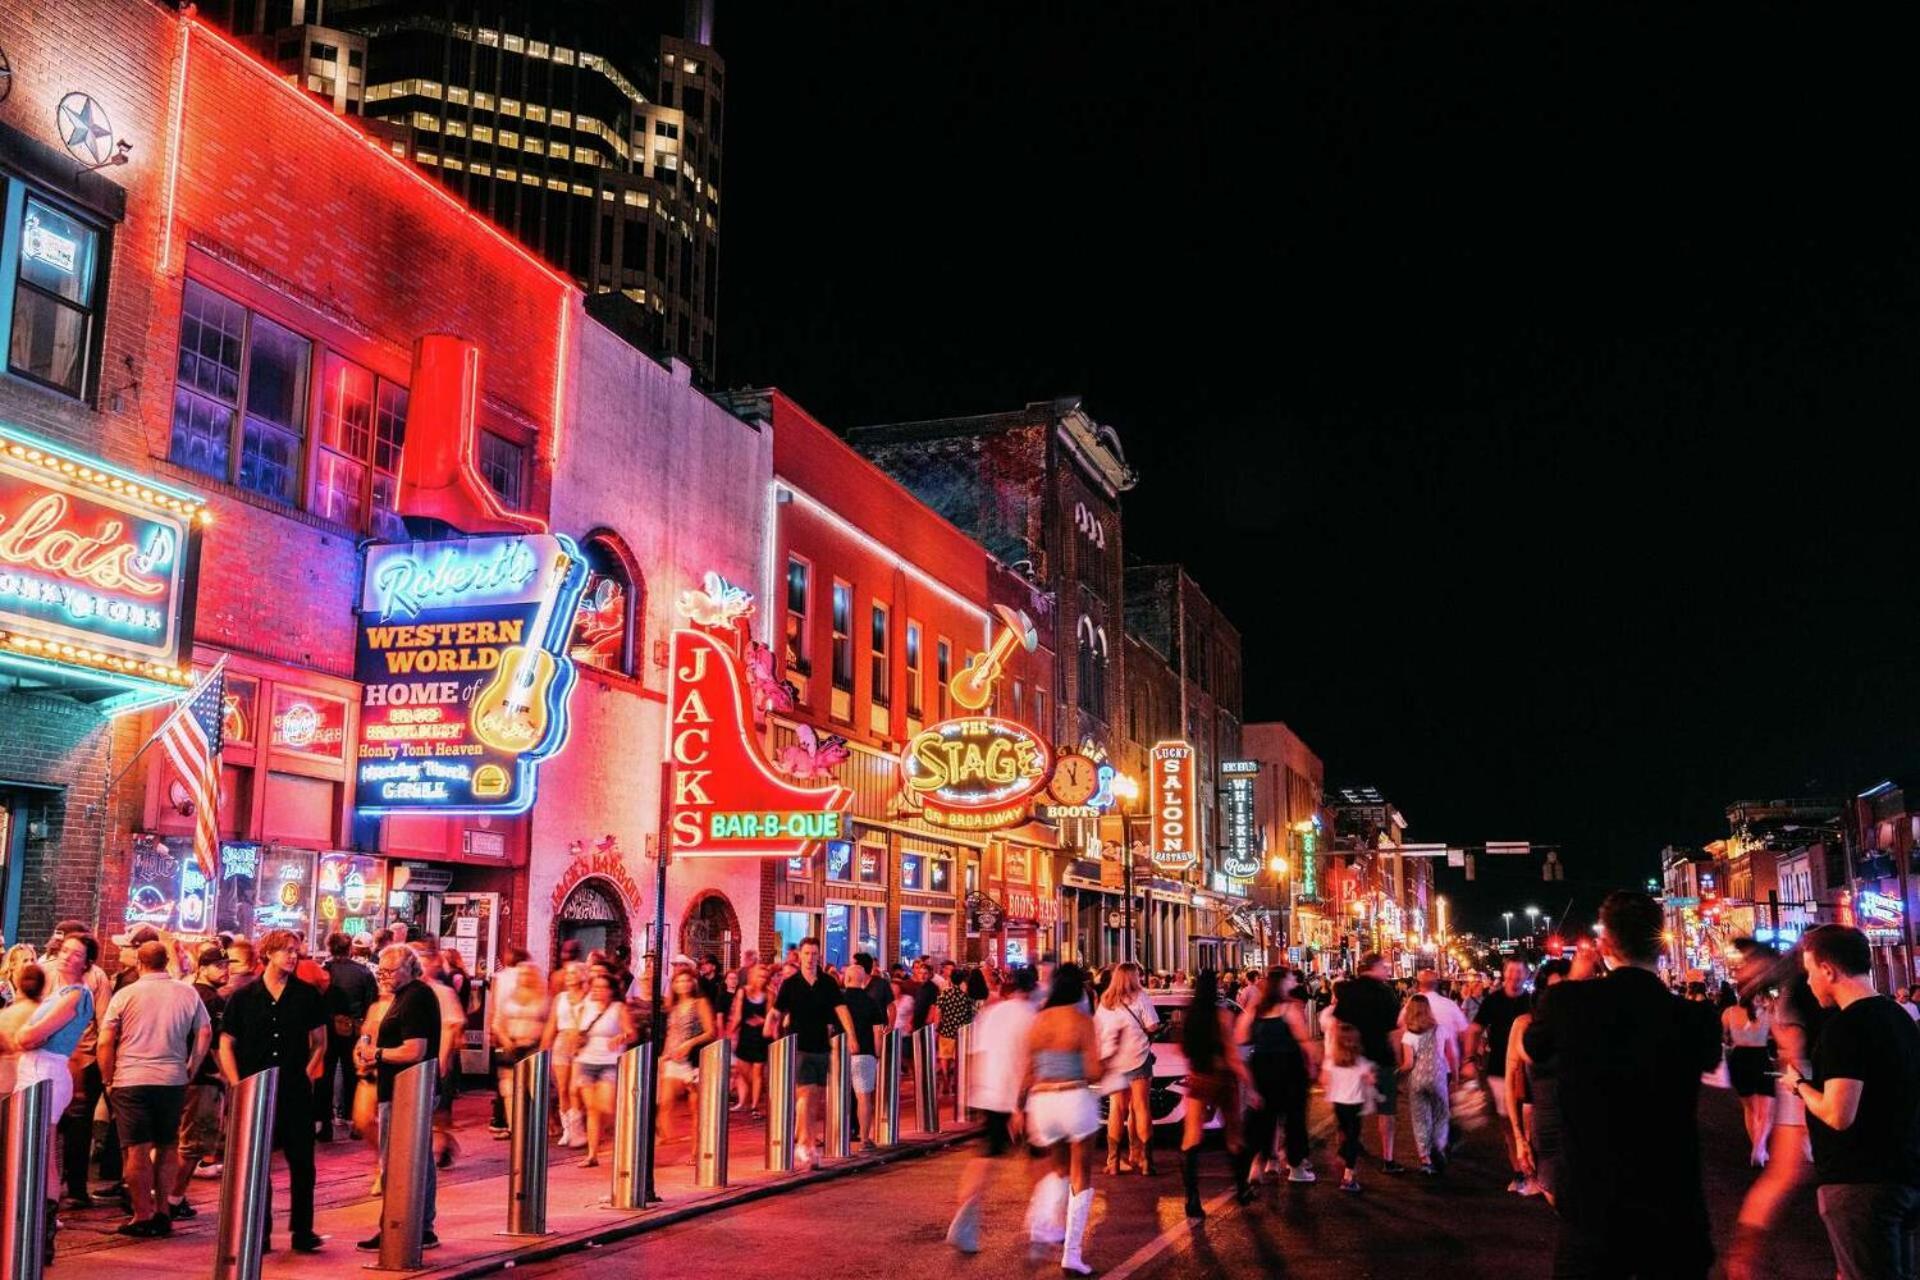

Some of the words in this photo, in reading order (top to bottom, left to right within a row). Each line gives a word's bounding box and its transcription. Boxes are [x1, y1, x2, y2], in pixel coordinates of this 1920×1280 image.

[0, 493, 164, 596] la's
[378, 540, 538, 623] Robert's
[366, 619, 524, 649] WESTERN
[385, 647, 500, 674] WORLD
[365, 681, 460, 706] HOME
[462, 679, 484, 709] of
[960, 720, 989, 736] THE
[358, 742, 400, 760] Honky
[400, 742, 433, 757] Tonk
[434, 743, 484, 757] Heaven
[672, 647, 715, 848] JACKS
[1155, 748, 1188, 760] LUCKY
[910, 732, 1044, 791] STAGE
[948, 806, 1023, 826] BROADWAY
[1047, 805, 1100, 818] BOOTS
[1162, 759, 1184, 851] SALOON
[711, 812, 840, 838] BAR-B-QUE
[1232, 778, 1248, 860] WHISKEY
[1227, 857, 1258, 877] Row
[1009, 894, 1035, 920] BOOTS
